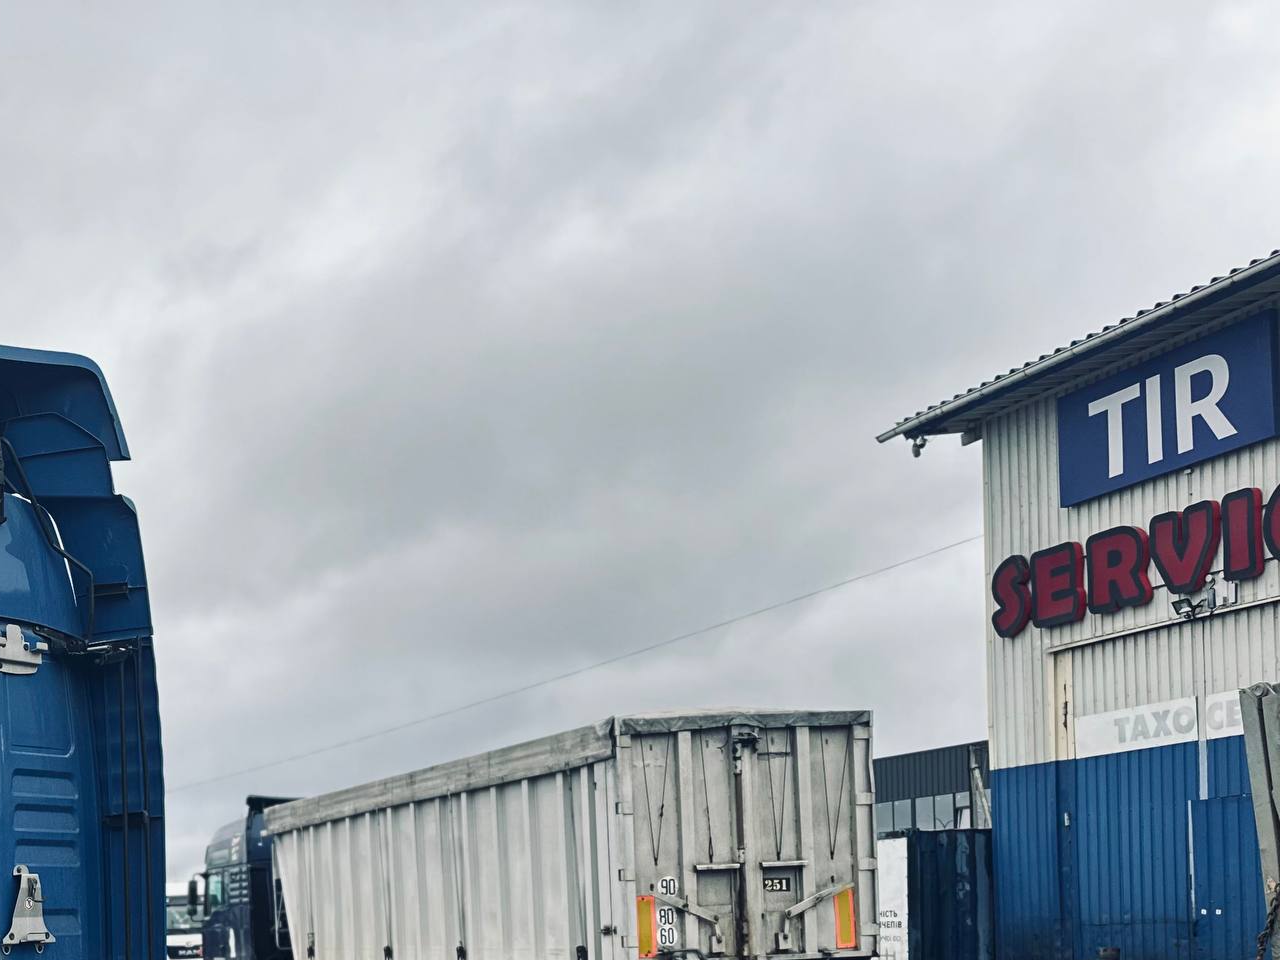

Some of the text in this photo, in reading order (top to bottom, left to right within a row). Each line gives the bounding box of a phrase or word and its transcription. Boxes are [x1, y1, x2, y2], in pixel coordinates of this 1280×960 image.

[1088, 354, 1238, 479] TIR
[991, 482, 1280, 638] SERVI
[1114, 705, 1195, 745] TAXO
[660, 877, 676, 896] 90
[764, 879, 788, 891] 251
[658, 907, 673, 926] 80
[659, 927, 675, 945] 60
